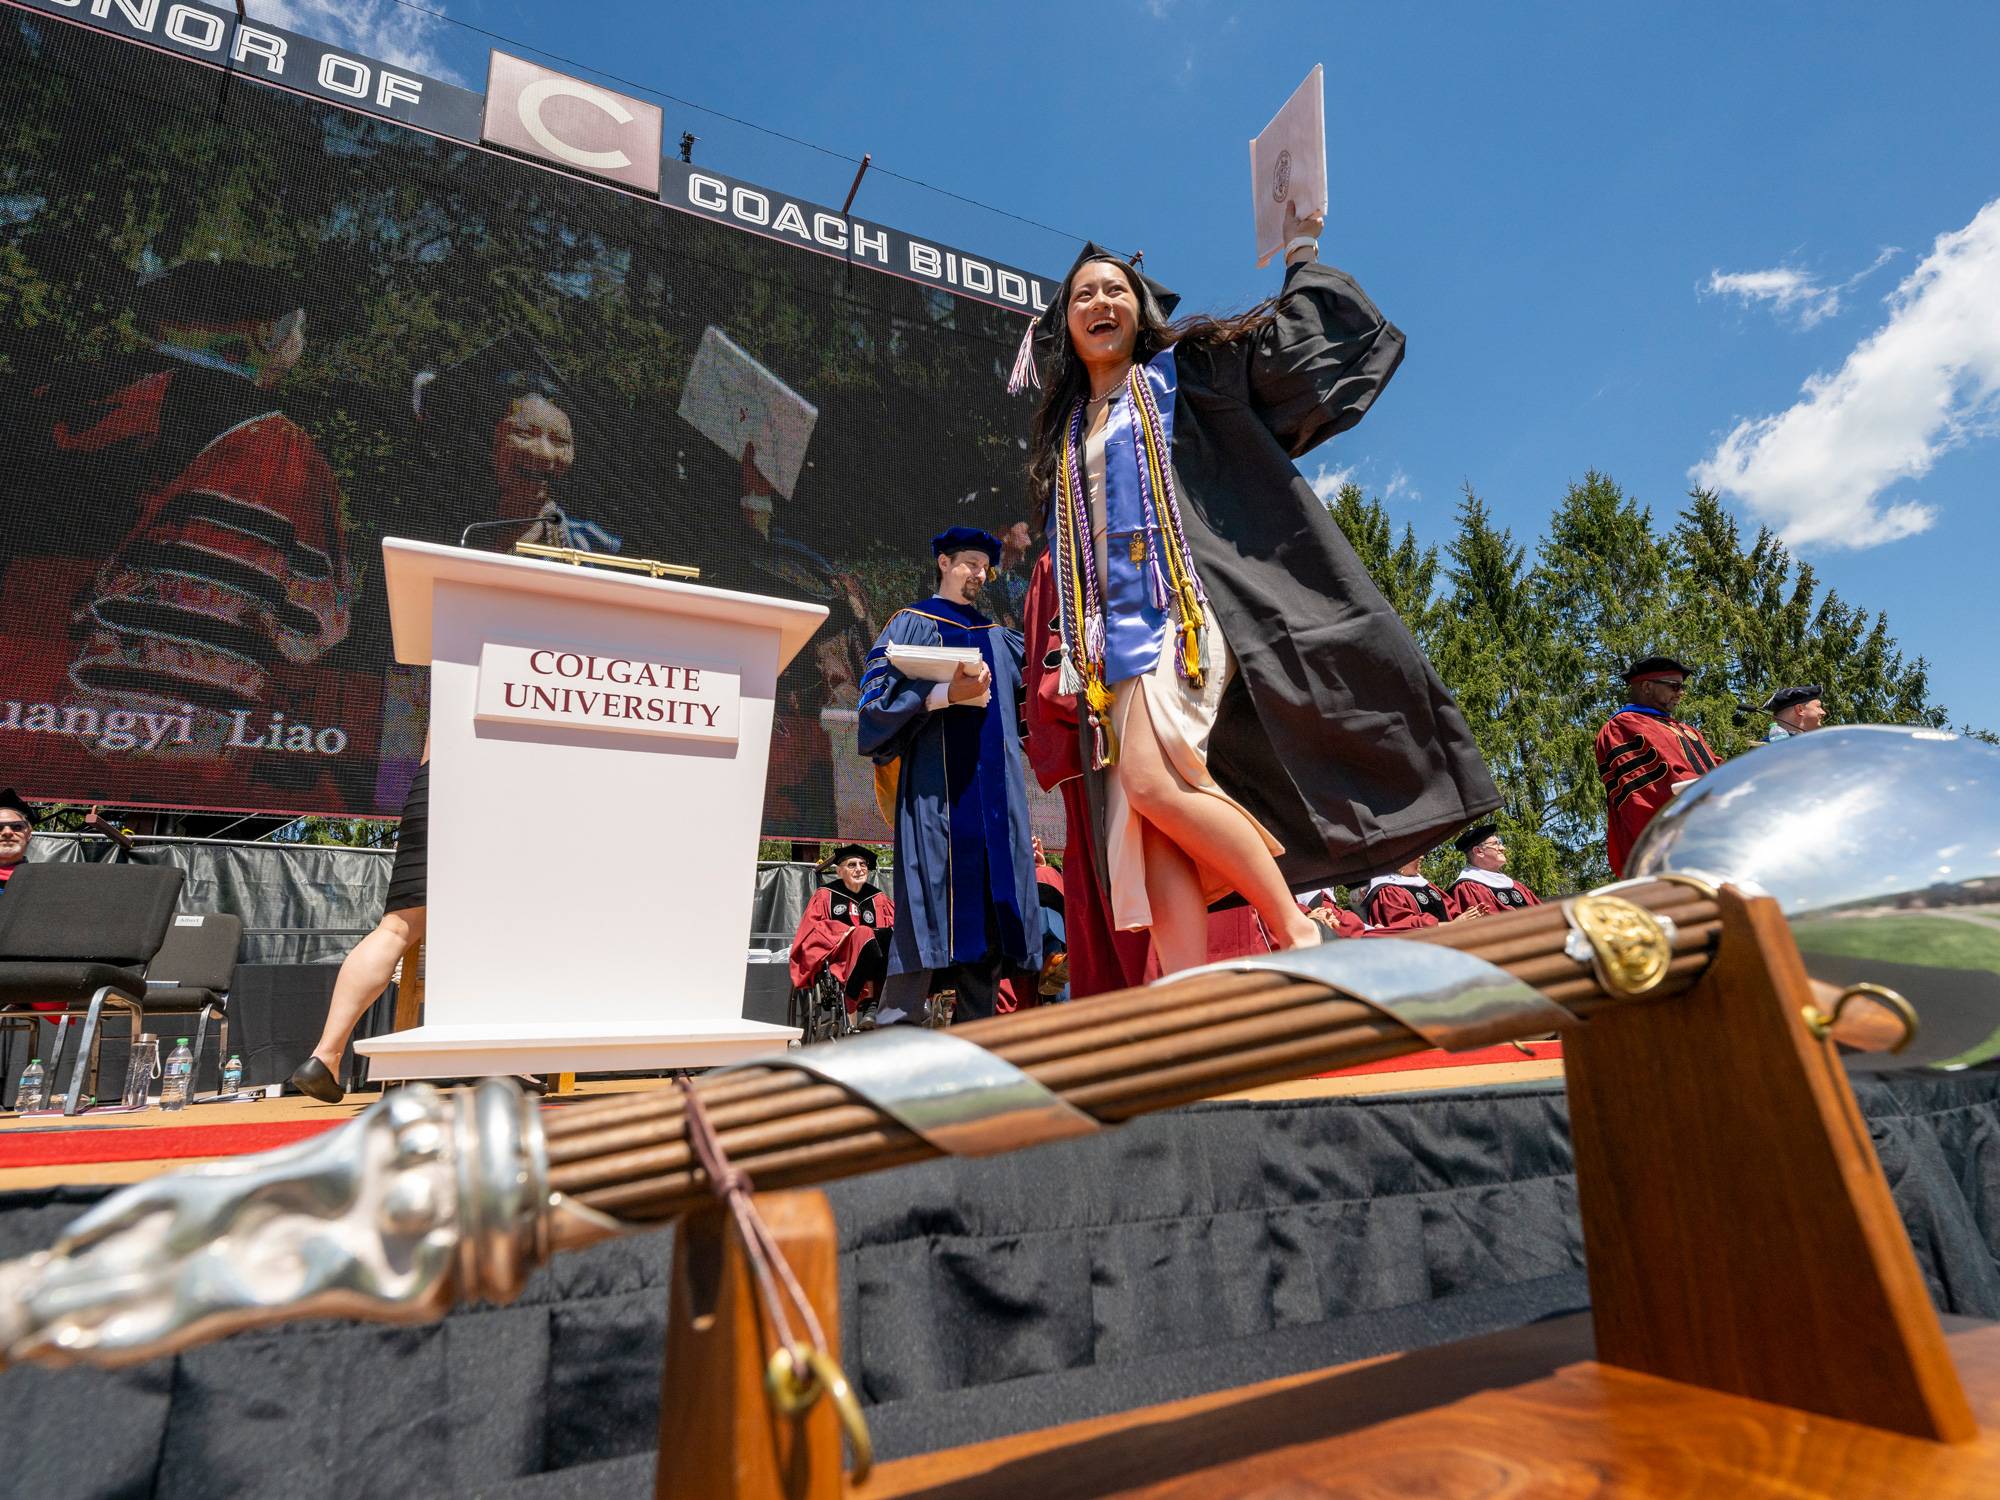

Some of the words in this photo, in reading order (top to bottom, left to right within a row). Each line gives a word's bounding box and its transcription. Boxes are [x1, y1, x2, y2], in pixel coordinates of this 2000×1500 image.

[53, 0, 287, 74] NOR
[318, 54, 423, 107] OF
[517, 78, 634, 169] C
[688, 173, 888, 263] COACH
[530, 650, 700, 691] COLGATE
[226, 709, 348, 754] Liao
[505, 683, 720, 727] UNIVERSITY
